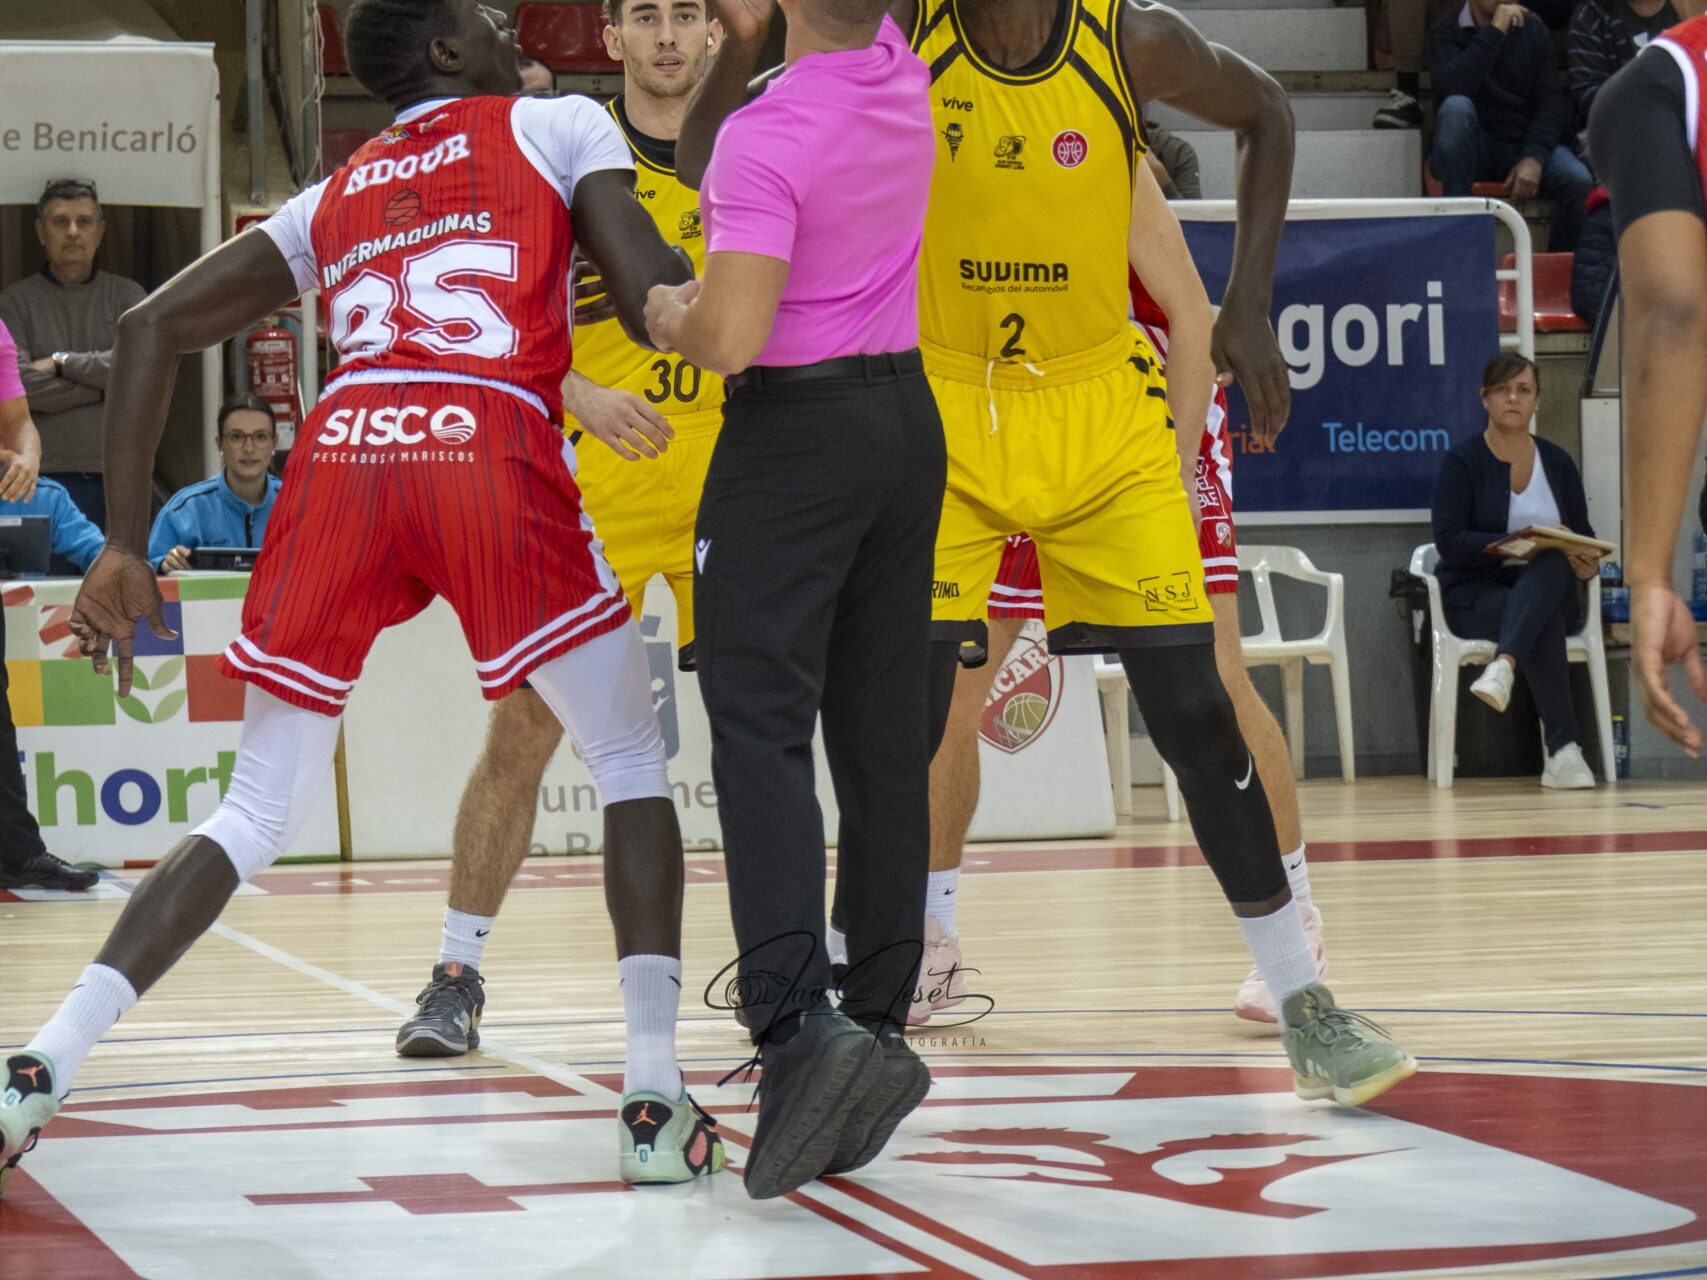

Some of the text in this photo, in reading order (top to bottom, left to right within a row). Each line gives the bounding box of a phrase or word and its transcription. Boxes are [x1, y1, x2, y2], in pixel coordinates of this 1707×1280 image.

[942, 97, 974, 112] vive
[33, 122, 197, 154] Benicarló
[343, 133, 470, 196] NDOUR
[323, 211, 492, 289] INTERMAQUINAS
[1008, 284, 1022, 293] del
[1000, 312, 1026, 359] 2
[1277, 280, 1446, 391] gori
[644, 358, 701, 404] 30
[1322, 422, 1449, 452] Telecom
[312, 452, 387, 464] PESCADOS
[401, 450, 474, 462] MARISCOS
